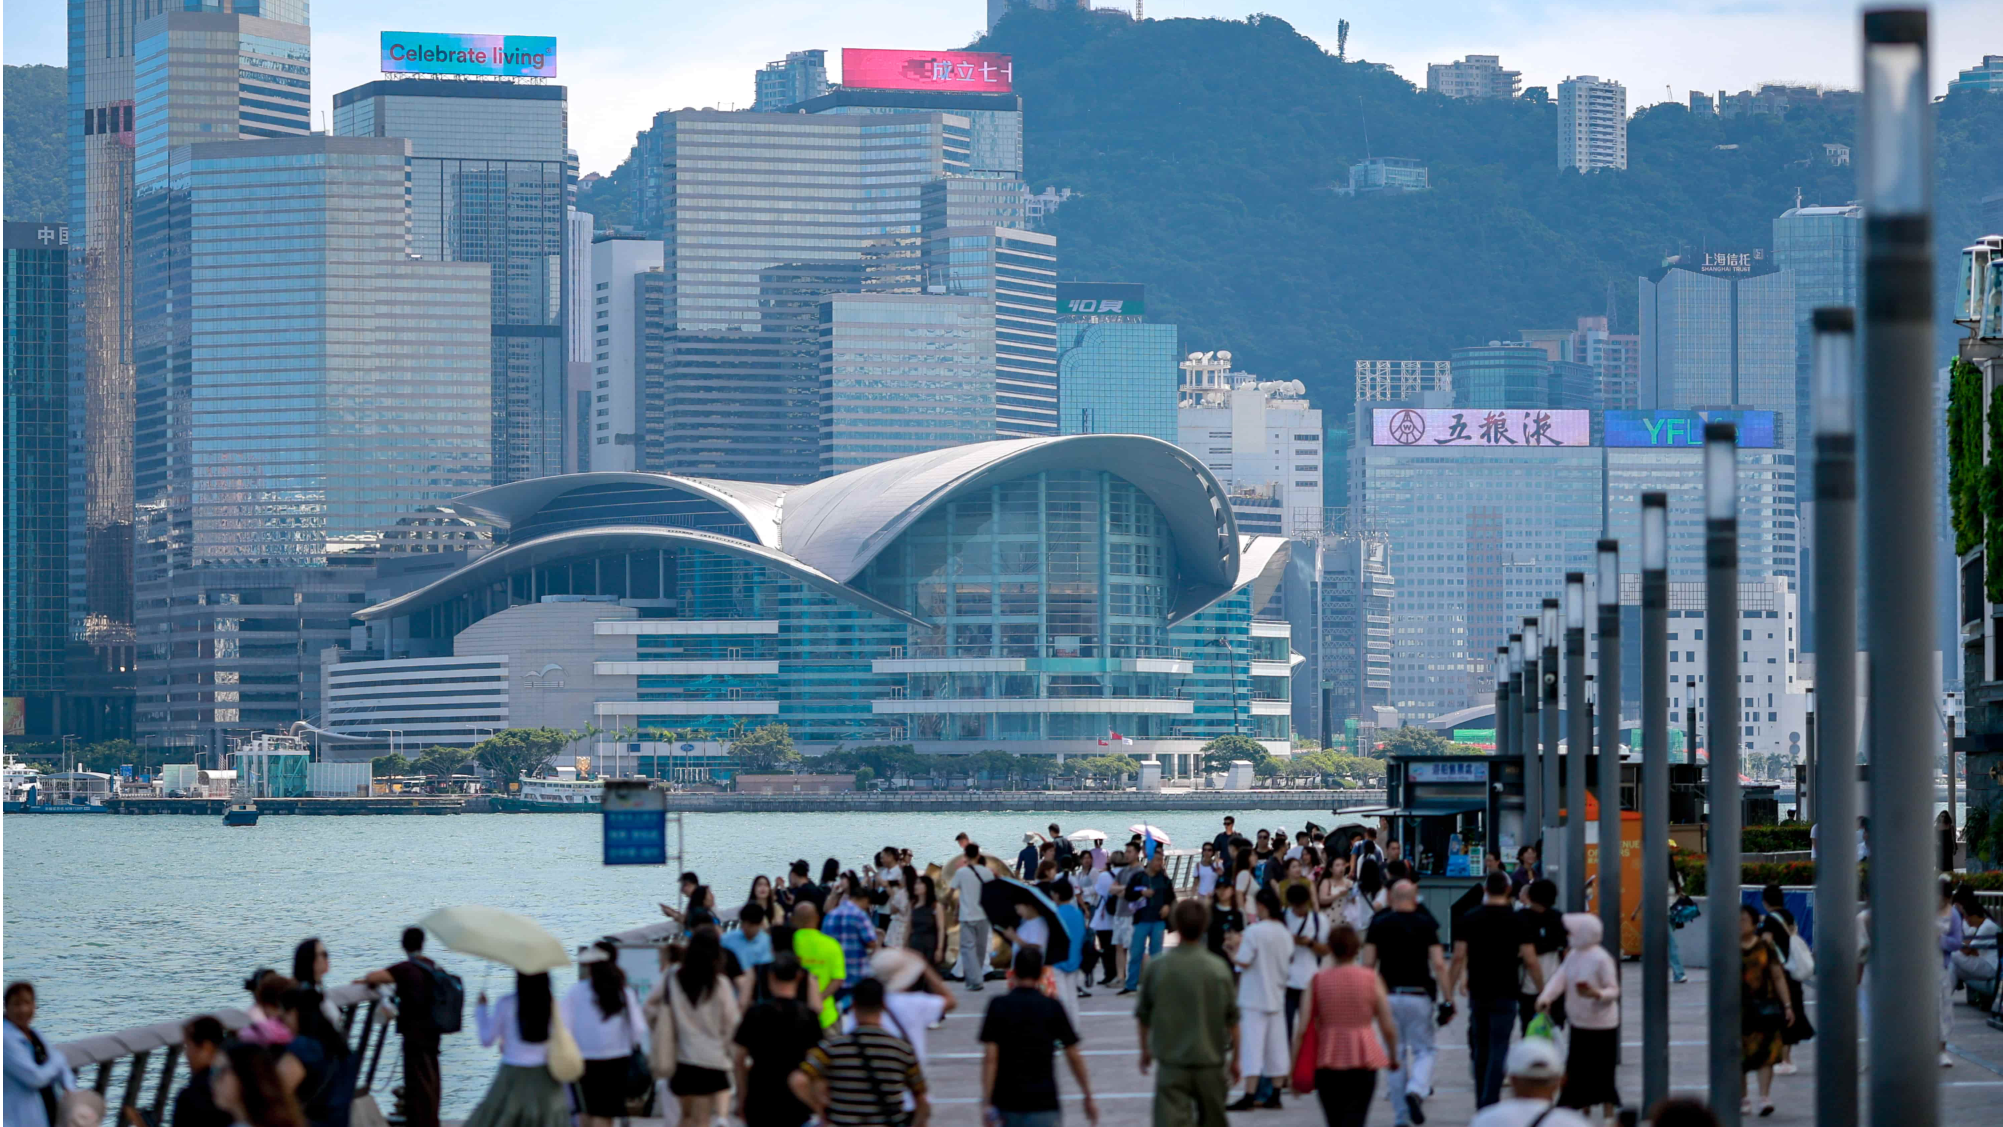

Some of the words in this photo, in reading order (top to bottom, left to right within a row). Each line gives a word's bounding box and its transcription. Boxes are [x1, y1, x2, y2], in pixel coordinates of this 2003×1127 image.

[389, 43, 487, 64] Celebrate
[493, 46, 545, 69] living
[1701, 253, 1751, 266] 上海信托
[1433, 410, 1564, 446] 五粮液
